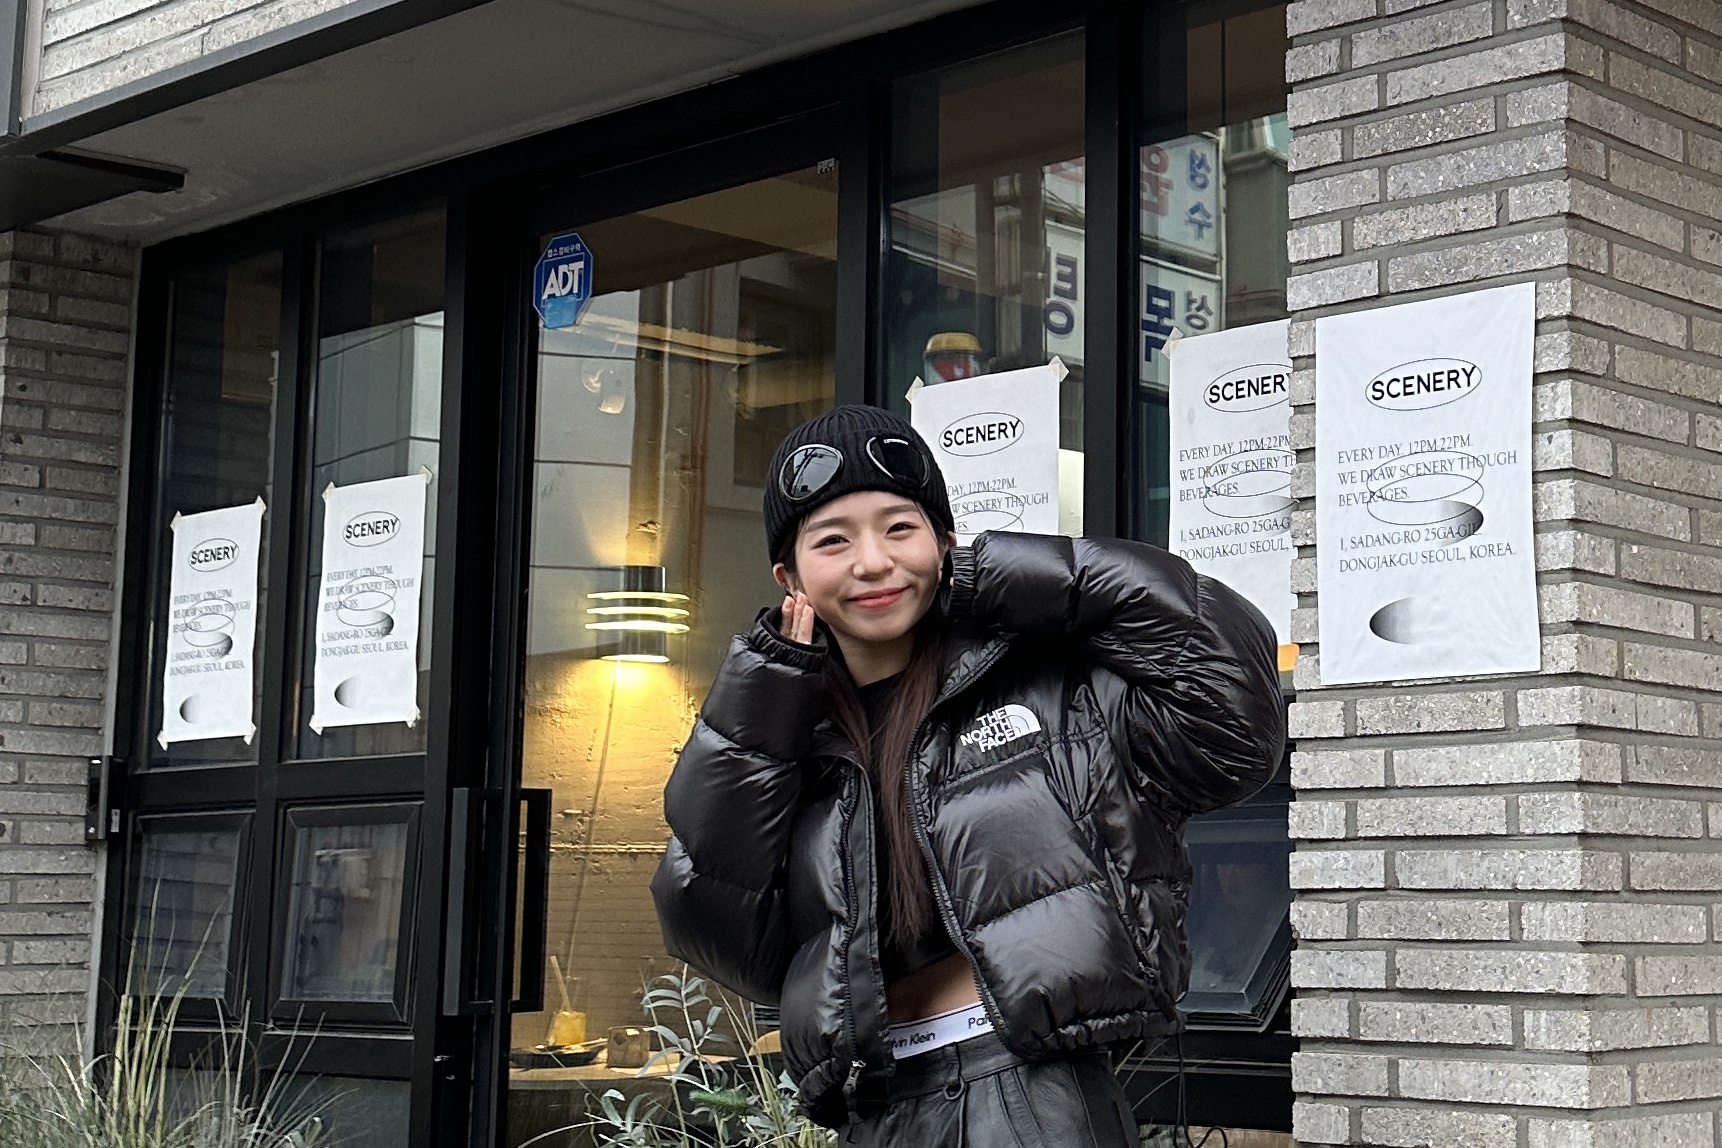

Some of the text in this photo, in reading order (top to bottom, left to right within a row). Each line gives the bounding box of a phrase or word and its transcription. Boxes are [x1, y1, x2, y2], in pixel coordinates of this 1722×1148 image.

[541, 261, 584, 300] ADT
[1209, 373, 1290, 403] SCENER
[1371, 366, 1477, 401] SCENERY
[943, 420, 1020, 448] SCENERY
[1180, 446, 1210, 462] EVERY
[1338, 446, 1375, 464] EVERY
[1180, 467, 1195, 481] WE
[1198, 463, 1229, 478] DRAW
[1231, 456, 1281, 473] SCENERY
[1338, 450, 1517, 485] WE DRAW SCENERY THOUGH
[962, 497, 1003, 513] SCENERY
[1005, 492, 1049, 508] THOUGH
[345, 517, 399, 539] SCENERY
[1189, 521, 1250, 541] SADANG-RO
[1252, 516, 1291, 533] 25GA-G
[1350, 529, 1421, 549] SADANG-RO
[190, 544, 238, 565] SCENERY
[1339, 551, 1418, 573] DONGJAK-GU
[1421, 547, 1466, 564] SEOUL,
[976, 706, 1008, 727] THE
[960, 717, 1013, 747] NORTH
[979, 729, 1017, 752] FACE
[909, 1030, 936, 1046] Klein
